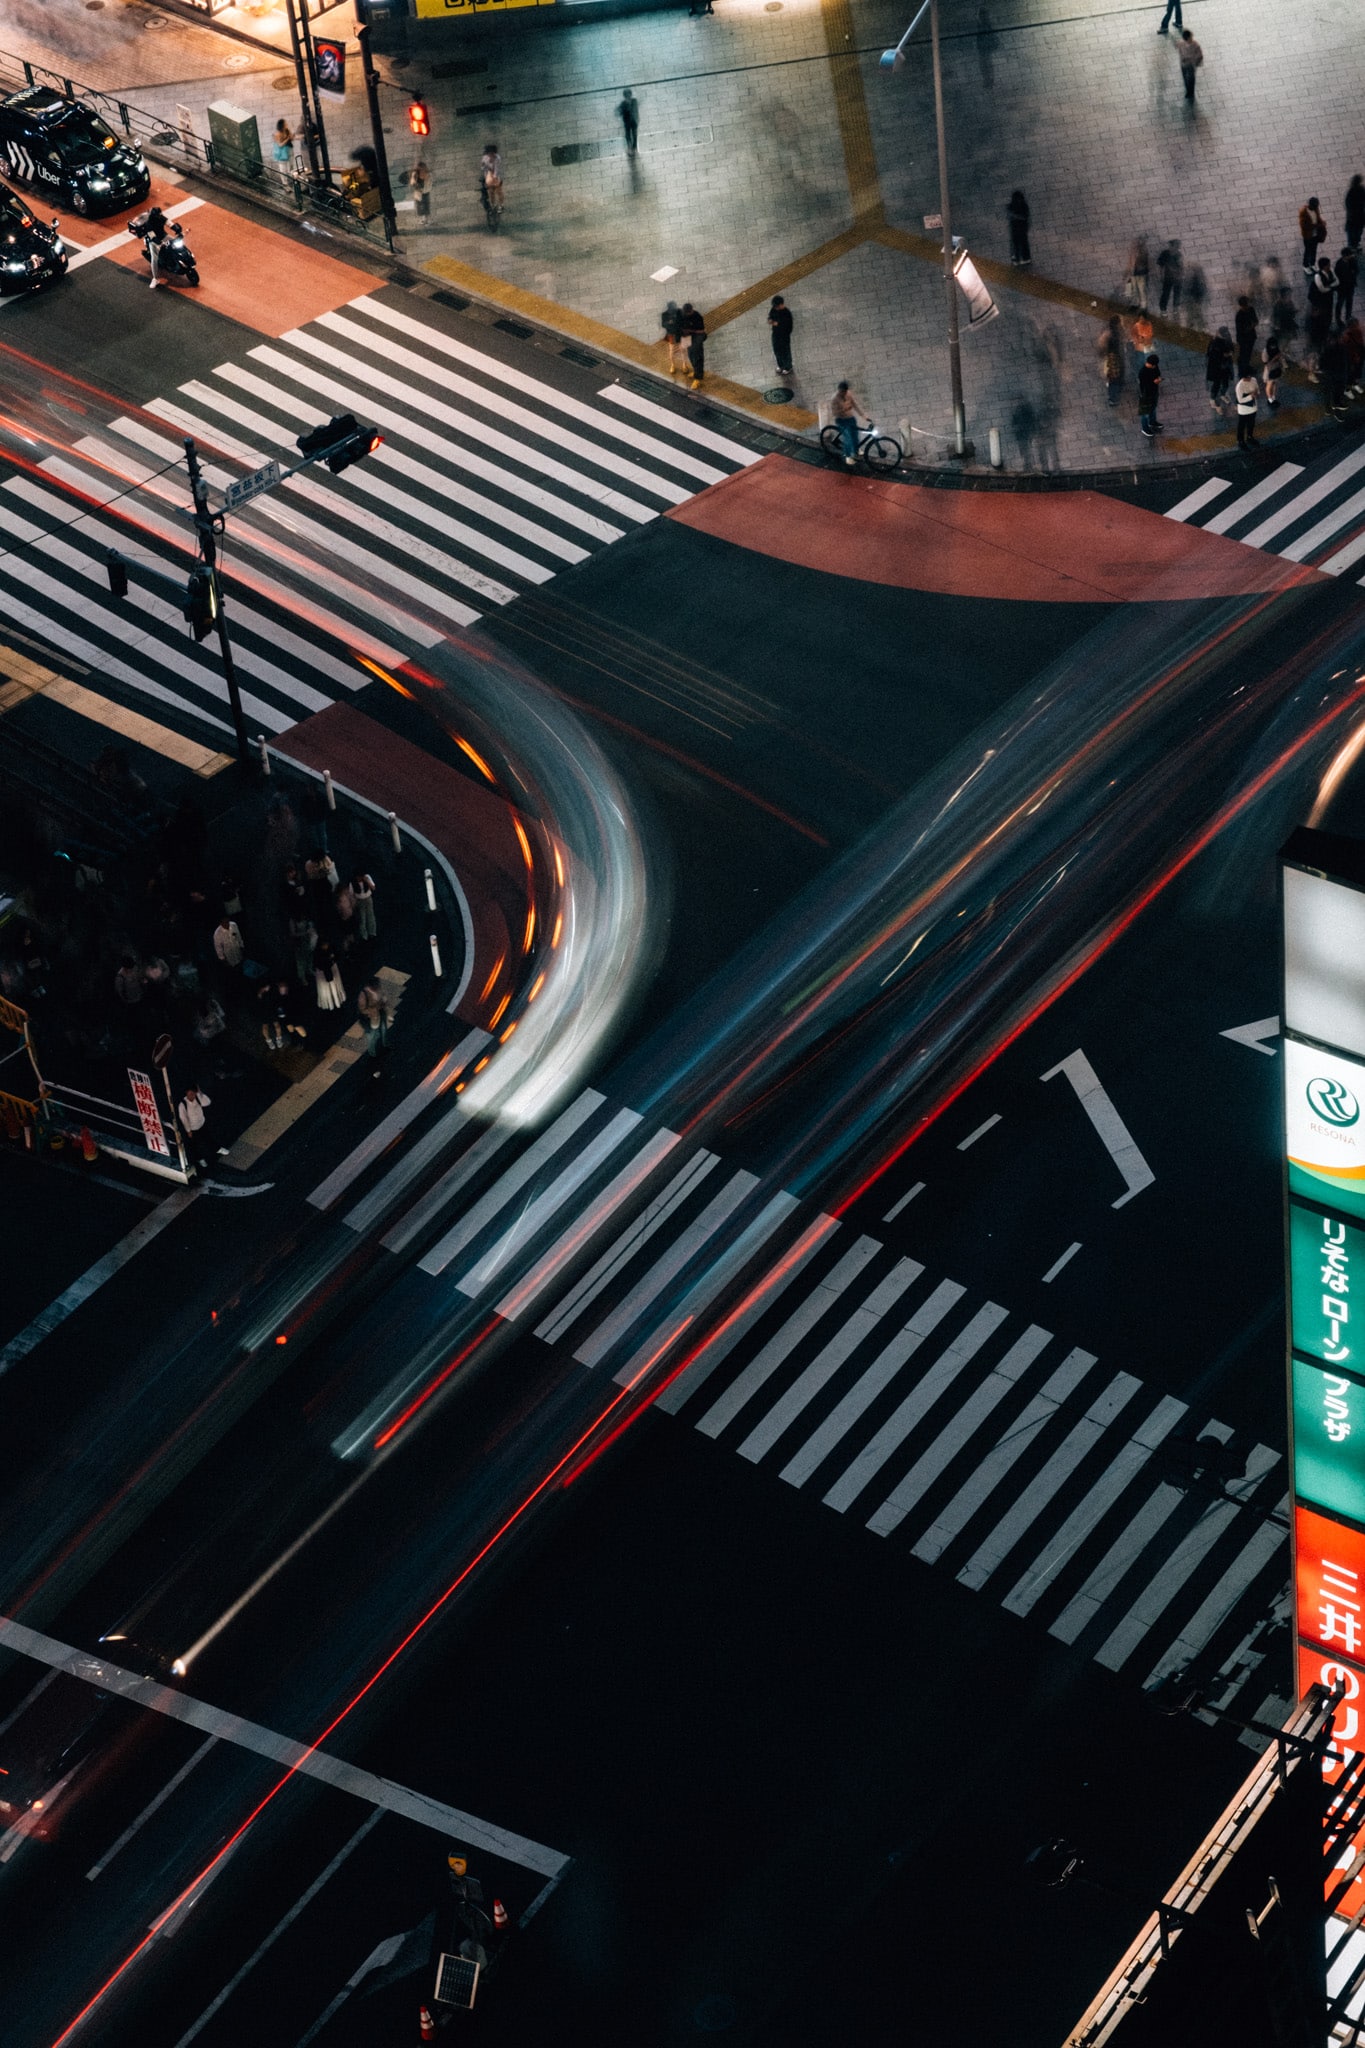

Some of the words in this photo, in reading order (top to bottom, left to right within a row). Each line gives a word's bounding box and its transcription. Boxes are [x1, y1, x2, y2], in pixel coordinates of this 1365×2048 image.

[37, 164, 61, 186] Uber
[134, 1081, 168, 1155] 横断禁止
[1310, 1122, 1356, 1145] RESONA
